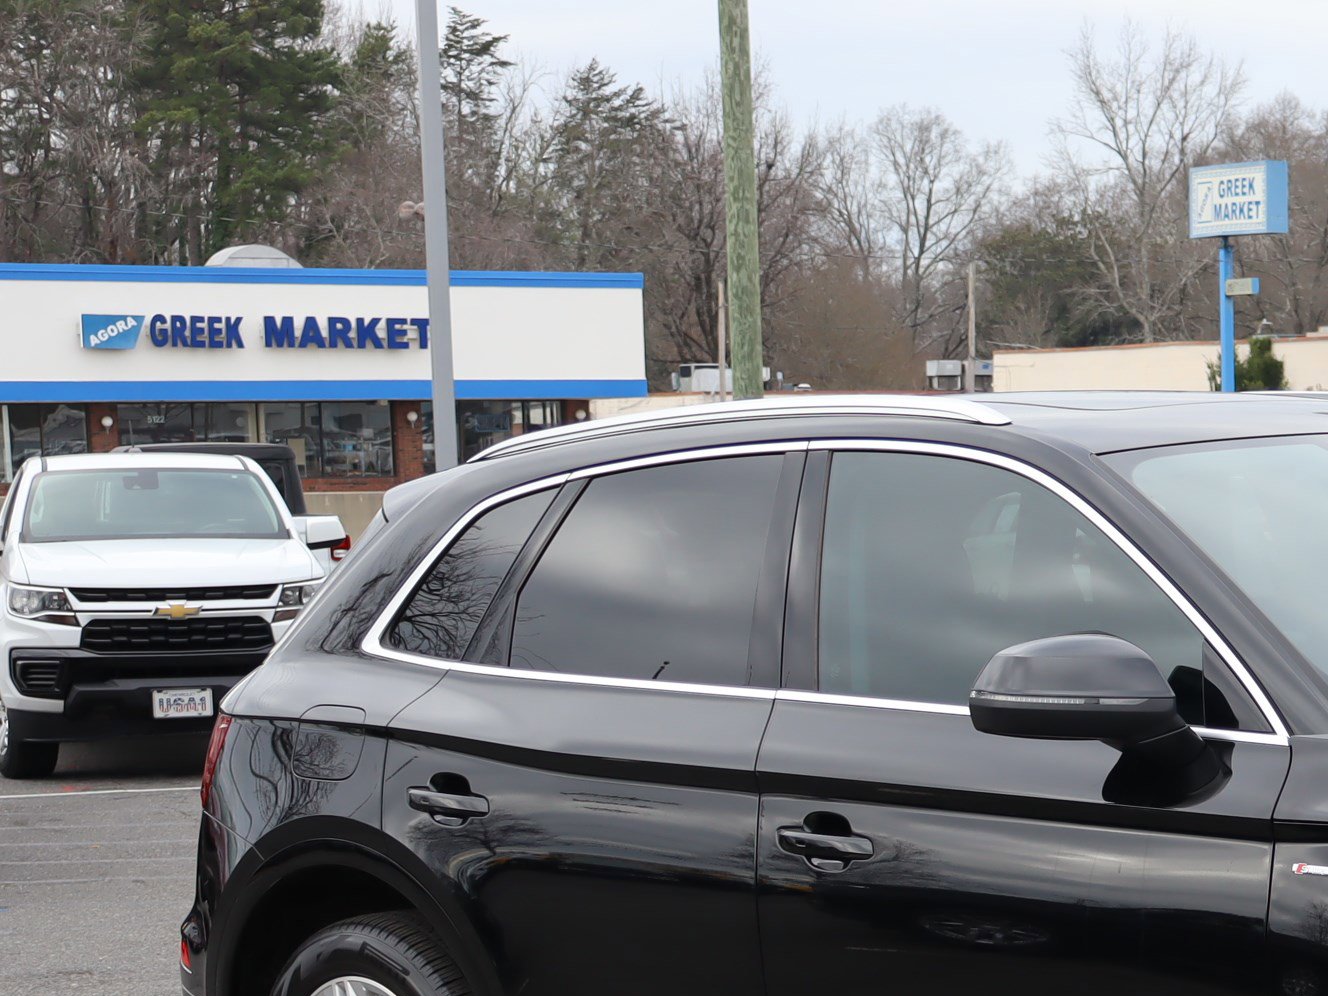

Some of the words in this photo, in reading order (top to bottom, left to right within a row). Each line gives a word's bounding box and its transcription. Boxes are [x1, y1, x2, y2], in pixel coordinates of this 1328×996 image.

[1218, 177, 1256, 198] GREEK
[1214, 201, 1261, 220] MARKET
[89, 316, 138, 347] AGORA
[150, 314, 245, 348] GREEK
[263, 316, 430, 349] MARKET
[147, 415, 166, 424] 5122
